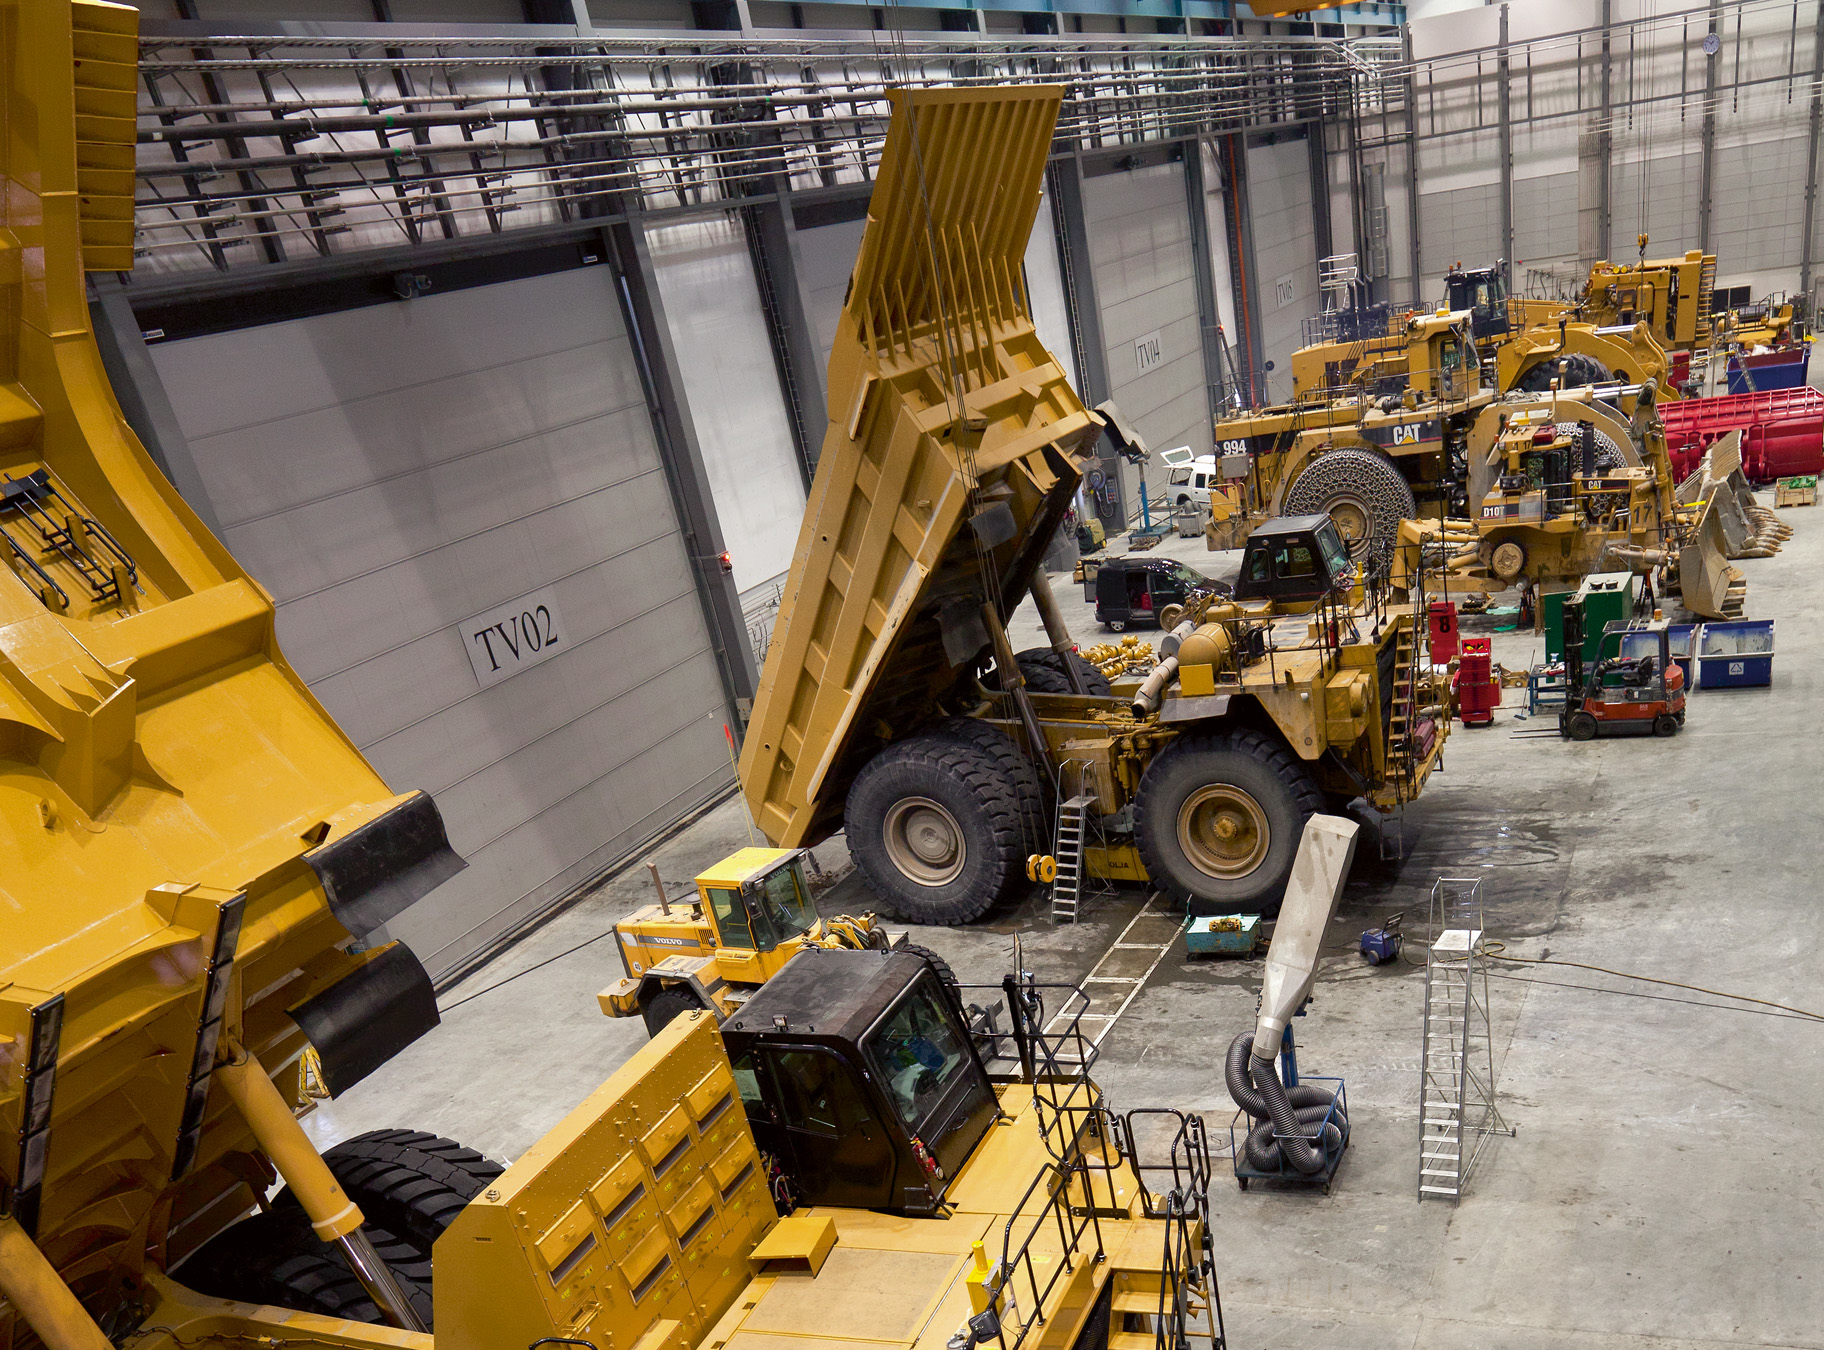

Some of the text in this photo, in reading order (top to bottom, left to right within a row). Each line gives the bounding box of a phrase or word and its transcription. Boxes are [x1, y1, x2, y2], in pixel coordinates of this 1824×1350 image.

[1137, 337, 1161, 369] TV04
[1392, 423, 1421, 446] CAT
[1223, 439, 1247, 456] 994
[1588, 480, 1603, 490] CAT
[1483, 506, 1505, 517] D10T
[1633, 504, 1653, 524] 17
[1439, 615, 1451, 633] 8
[473, 604, 559, 672] TV02
[653, 937, 683, 946] VOLVO
